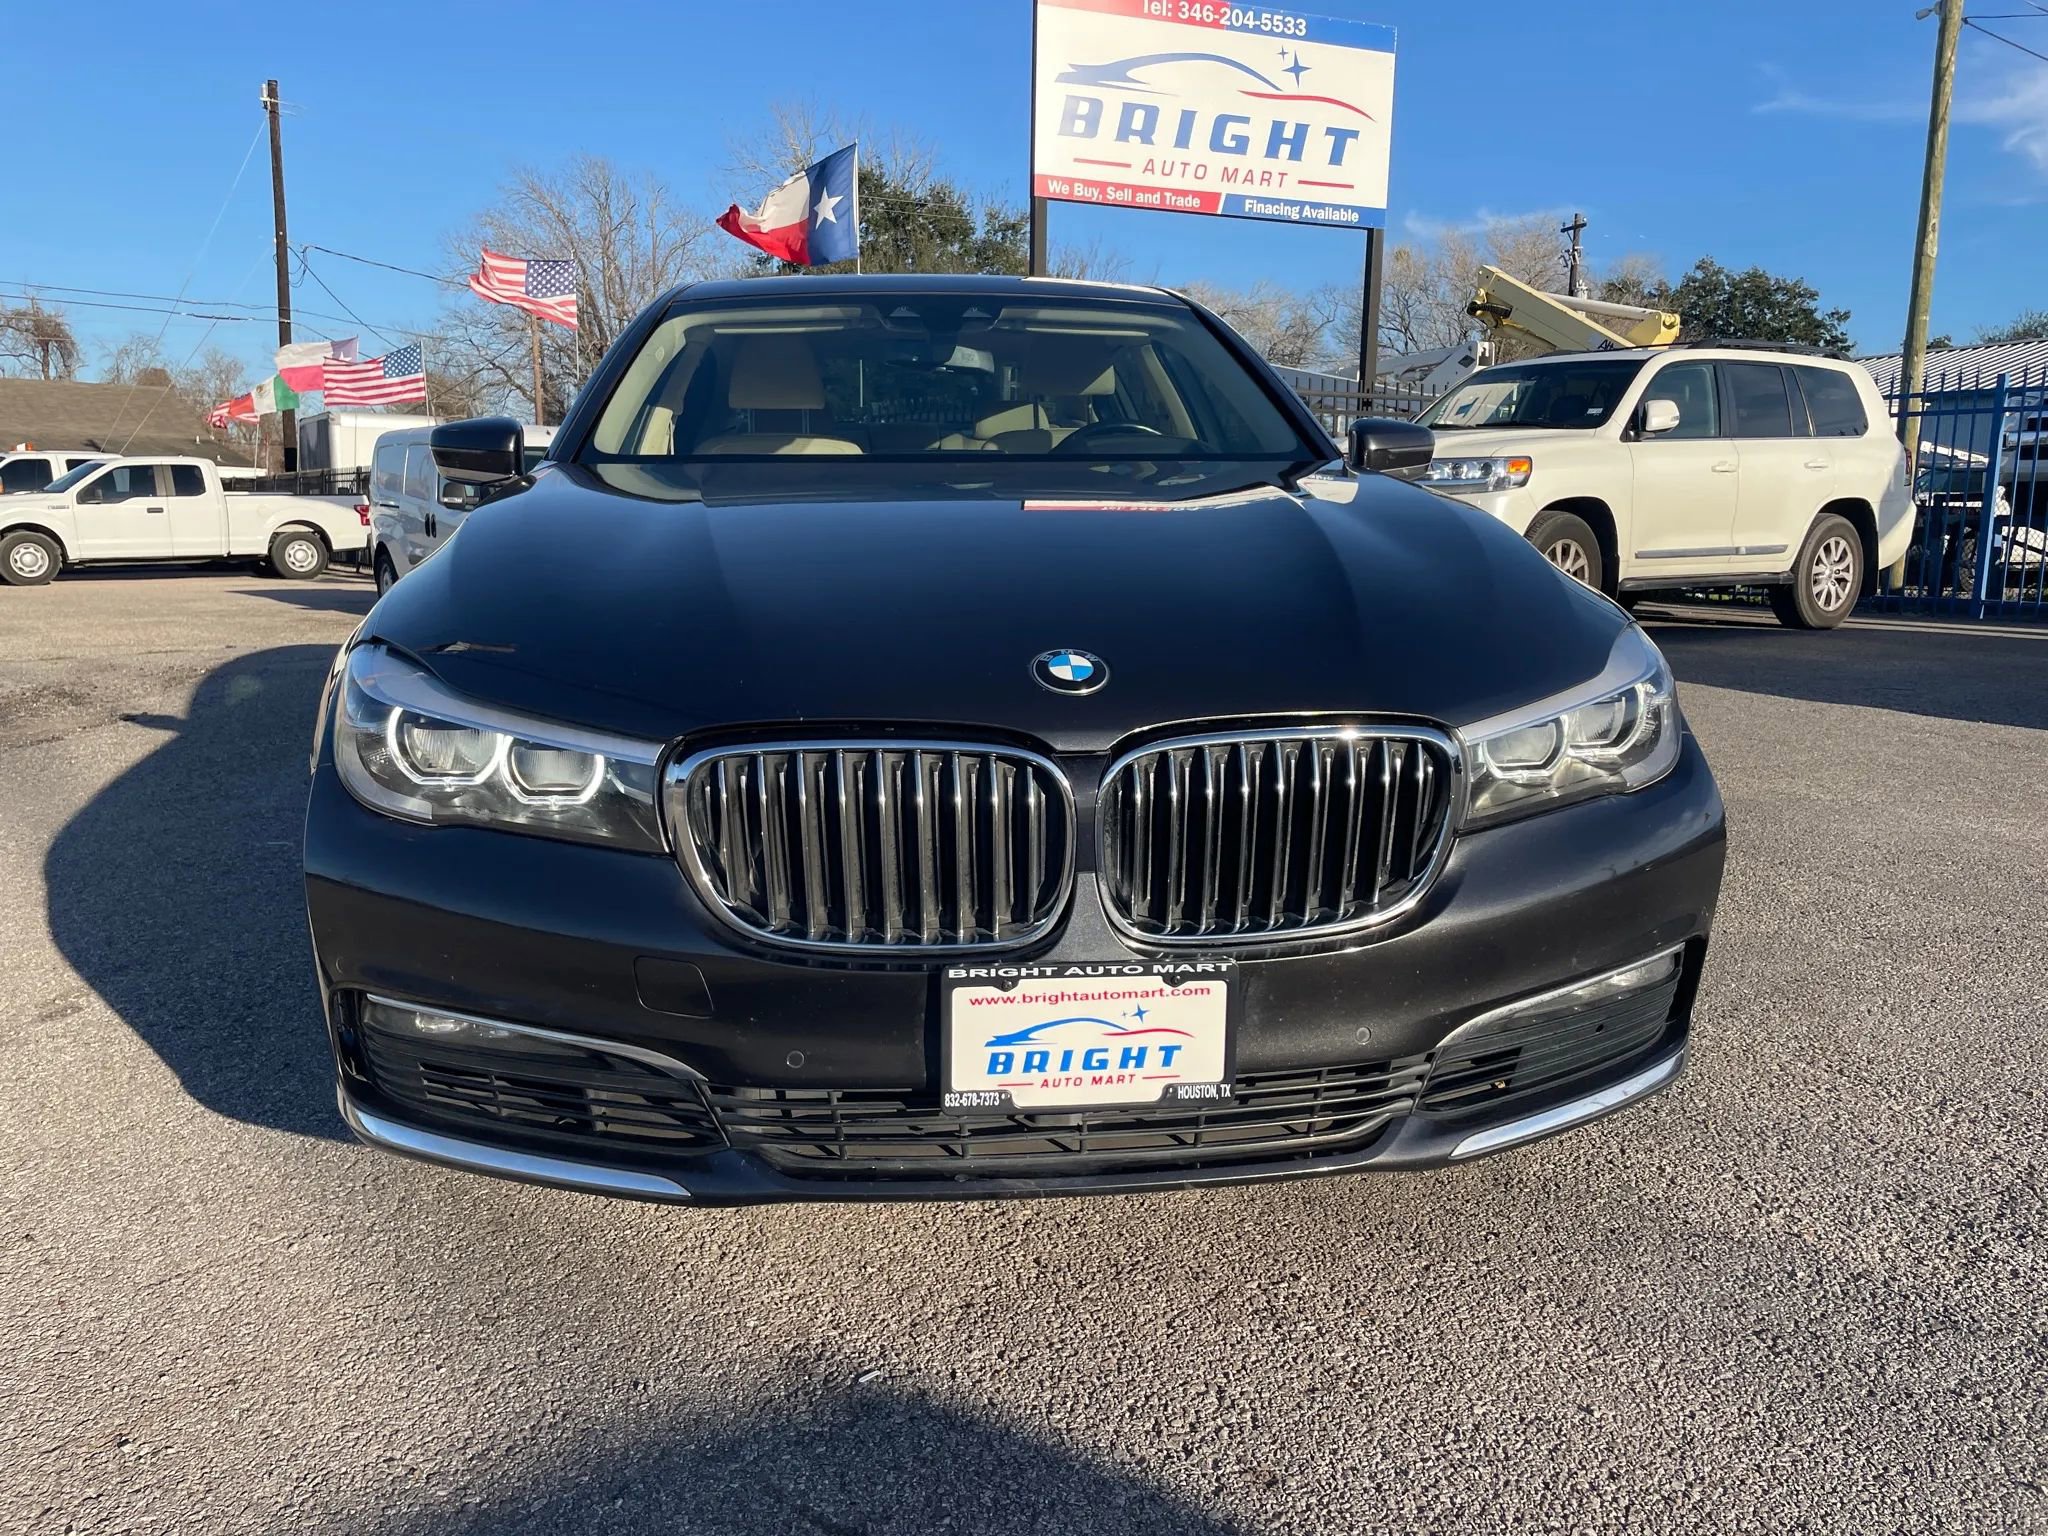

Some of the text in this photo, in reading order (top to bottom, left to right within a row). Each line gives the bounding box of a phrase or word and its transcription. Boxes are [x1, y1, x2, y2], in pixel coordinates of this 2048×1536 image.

[1143, 0, 1307, 37] Tel: 346-204-5533
[1057, 94, 1361, 167] BRIGHT
[1142, 158, 1289, 188] AUTO MART
[1047, 179, 1201, 208] We Buy, Sell and Trade
[1244, 199, 1360, 222] Finacing Available
[948, 962, 1233, 979] BRIGHT AUTO MART
[968, 986, 1211, 1006] www.brightautomart.com
[985, 1044, 1182, 1075] BRIGHT
[1040, 1074, 1136, 1089] AUTO MART
[1177, 1083, 1231, 1100] HOUSTON, TX
[944, 1092, 1000, 1108] 832-678-7373
